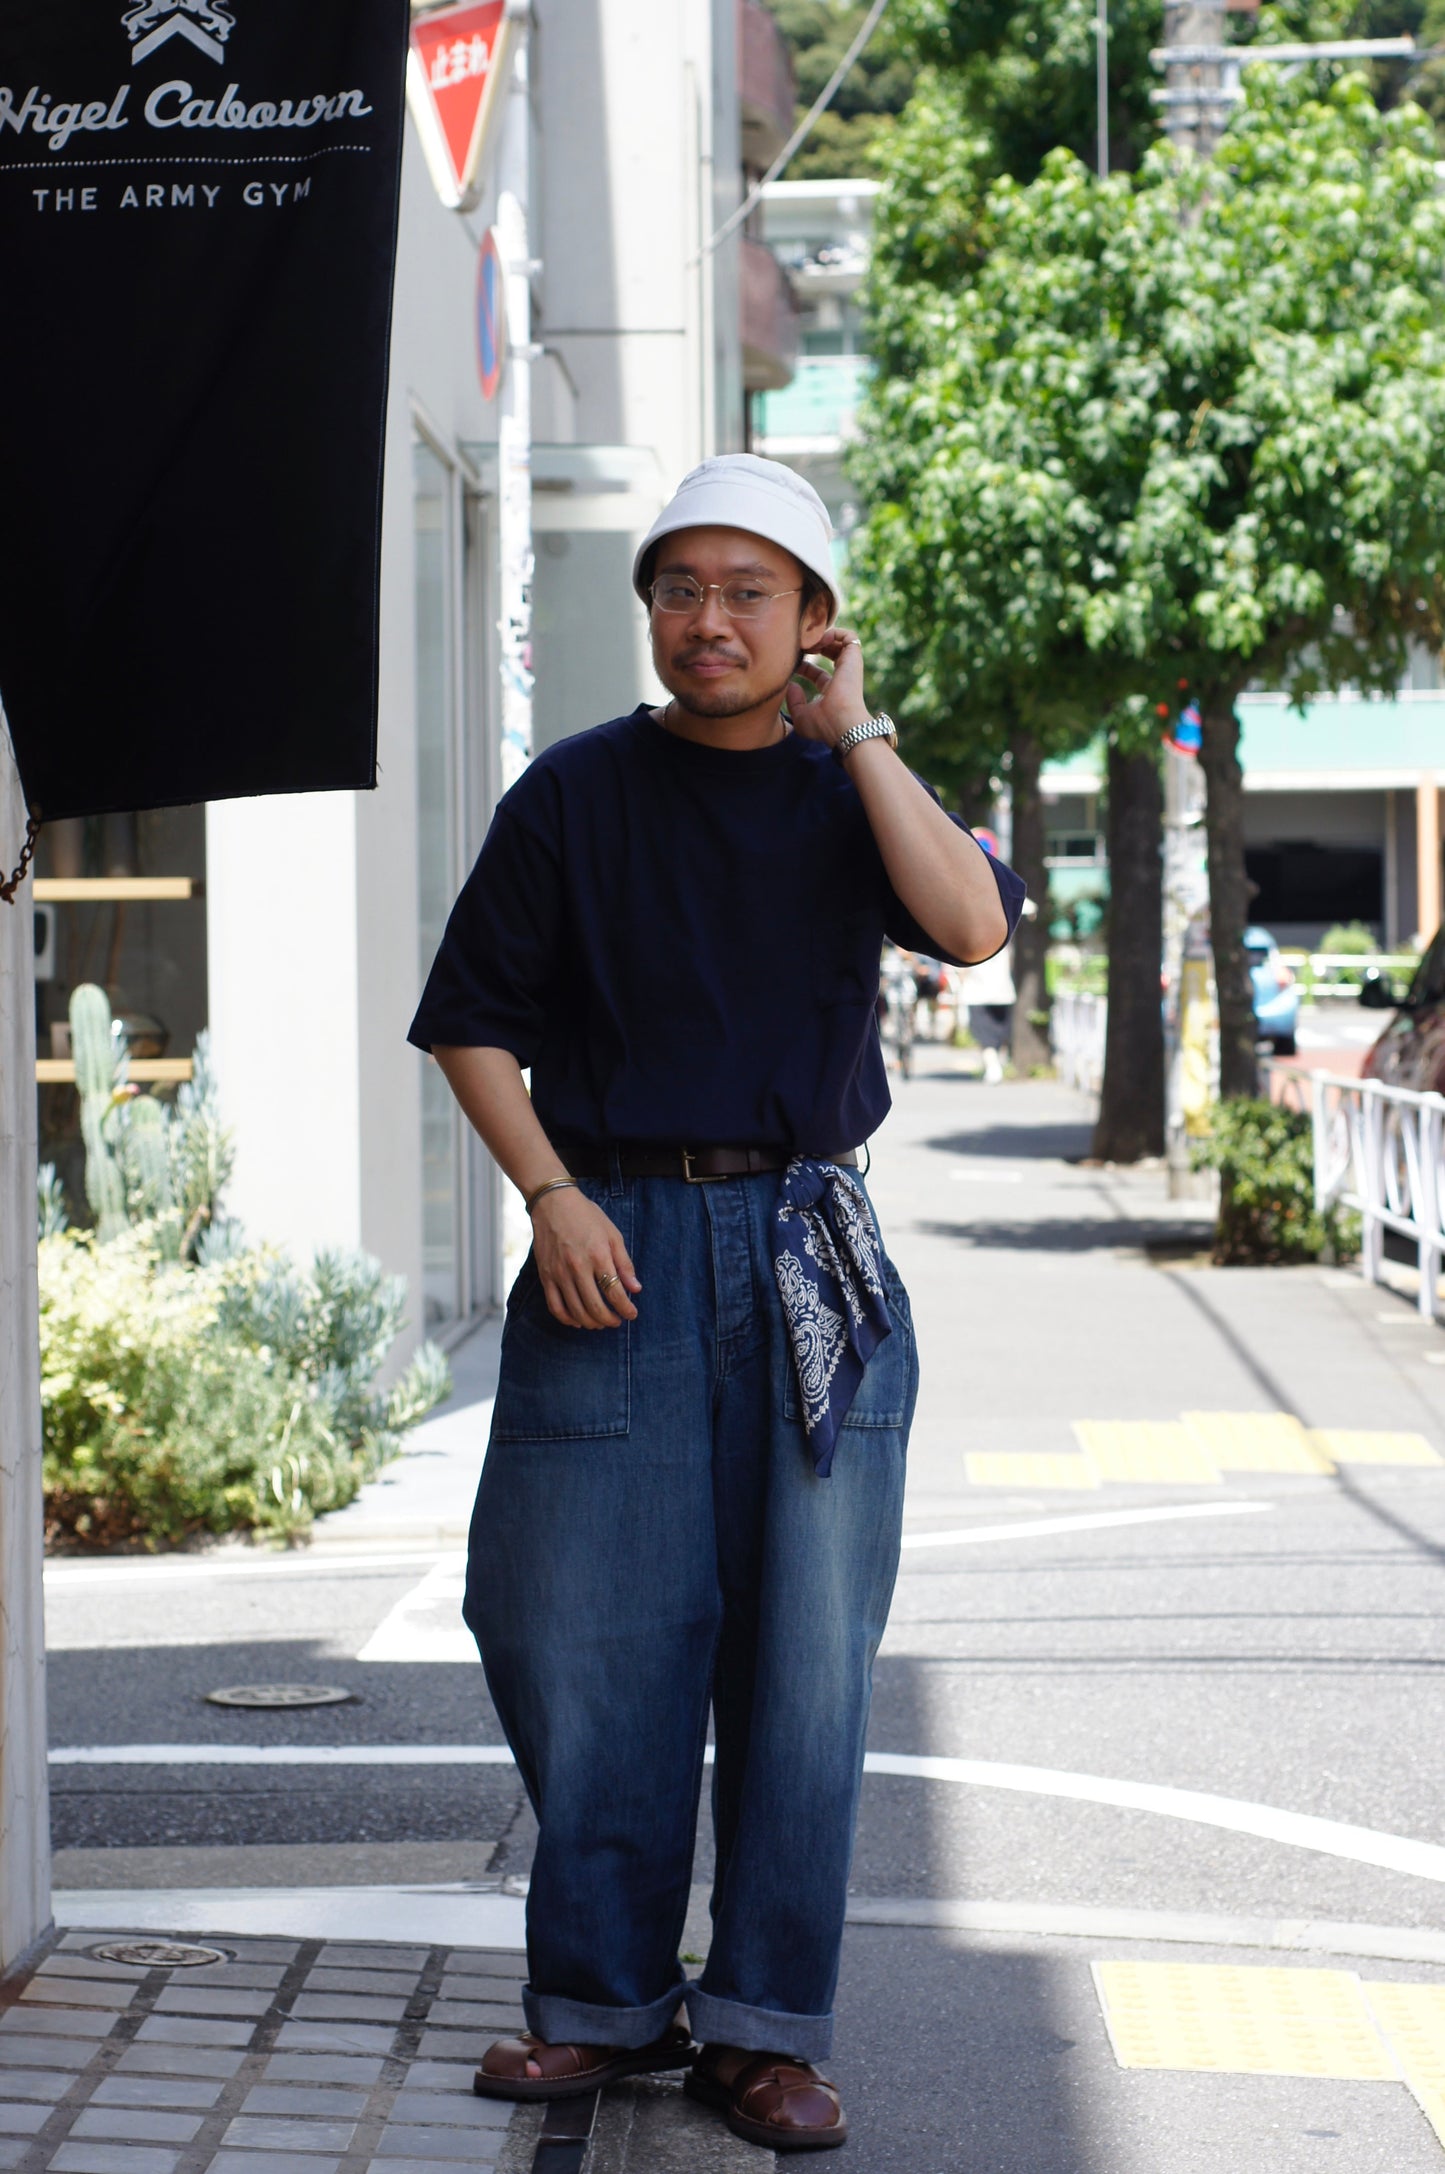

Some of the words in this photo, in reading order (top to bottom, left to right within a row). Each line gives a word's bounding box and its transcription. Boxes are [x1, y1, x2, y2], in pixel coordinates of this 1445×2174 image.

[431, 33, 489, 90] 止まれ
[0, 84, 130, 151] Nigel
[144, 79, 373, 129] Cabourn
[33, 187, 98, 211] THE
[119, 183, 221, 208] ARMY
[243, 177, 311, 206] GYM
